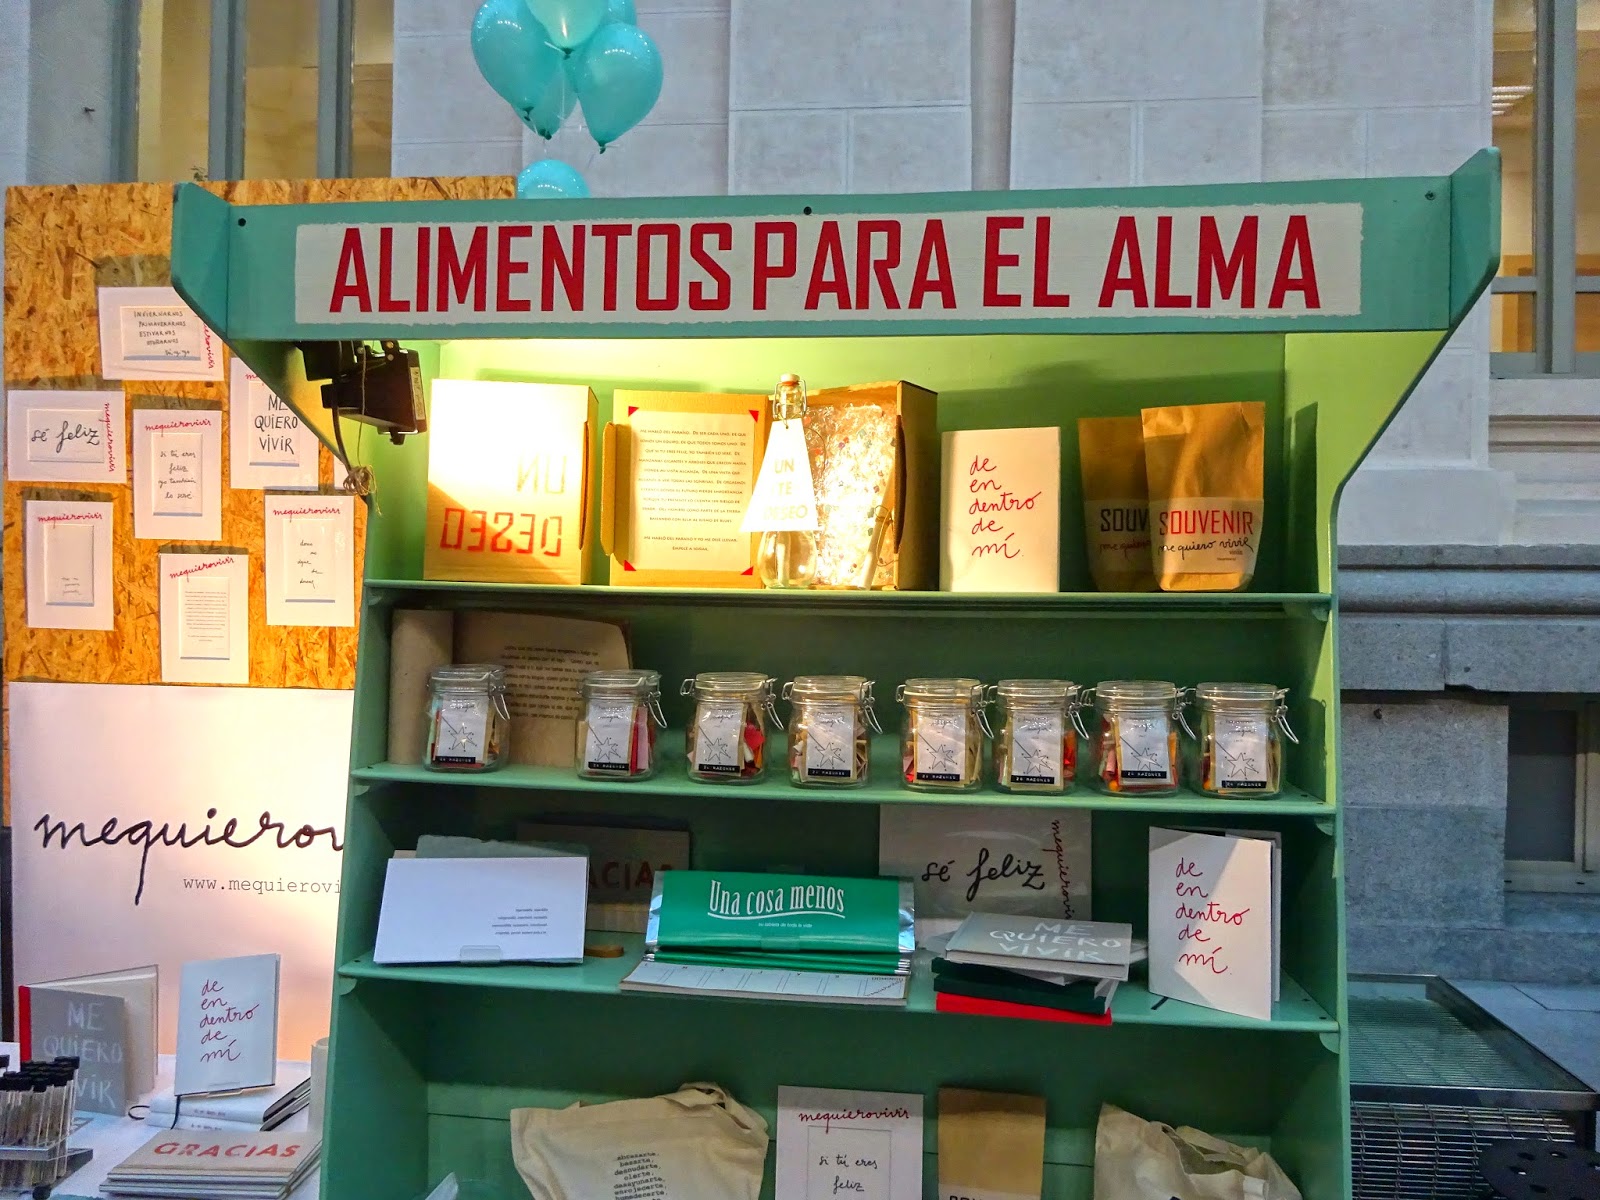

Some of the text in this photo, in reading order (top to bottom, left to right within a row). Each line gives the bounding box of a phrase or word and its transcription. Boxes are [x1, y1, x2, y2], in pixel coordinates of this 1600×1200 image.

[329, 215, 1321, 313] ALIMENTOS PARA EL ALMA
[268, 394, 289, 411] ME
[145, 418, 212, 438] mequierovivir
[254, 414, 298, 432] QUIERO
[31, 421, 100, 453] sé feliz
[259, 434, 295, 455] VIVIR
[970, 455, 997, 472] de
[970, 479, 1001, 493] en
[969, 492, 1042, 515] dentro
[38, 512, 102, 530] mequierovivir
[273, 507, 341, 523] mequierovivir
[1100, 508, 1149, 532] SOUV
[1159, 510, 1253, 535] SOUVENIR
[972, 518, 1004, 534] de
[1178, 541, 1216, 560] quiero
[1219, 537, 1254, 553] vivir
[170, 556, 234, 583] mequierovivir
[34, 808, 344, 905] mequierov
[921, 848, 1046, 902] sé feliz
[1176, 857, 1203, 878] de
[183, 877, 341, 894] www.mequierovi
[1176, 882, 1209, 898] en
[710, 880, 845, 916] Una cosa menos
[1176, 902, 1250, 926] dentro
[990, 930, 1122, 948] QUIERO
[1035, 922, 1094, 936] ME
[1178, 924, 1211, 942] de
[998, 942, 1106, 963] VIVIR
[202, 979, 223, 996] de
[201, 996, 228, 1010] en
[68, 1003, 104, 1030] ME
[200, 1004, 259, 1028] dentro
[201, 1030, 228, 1044] de
[43, 1036, 122, 1063] QUIERO
[200, 1040, 241, 1063] mí
[798, 1107, 910, 1134] mequierovivir
[154, 1142, 301, 1158] GRACIAS
[818, 1155, 878, 1170] si tú eres
[832, 1176, 865, 1195] feliz
